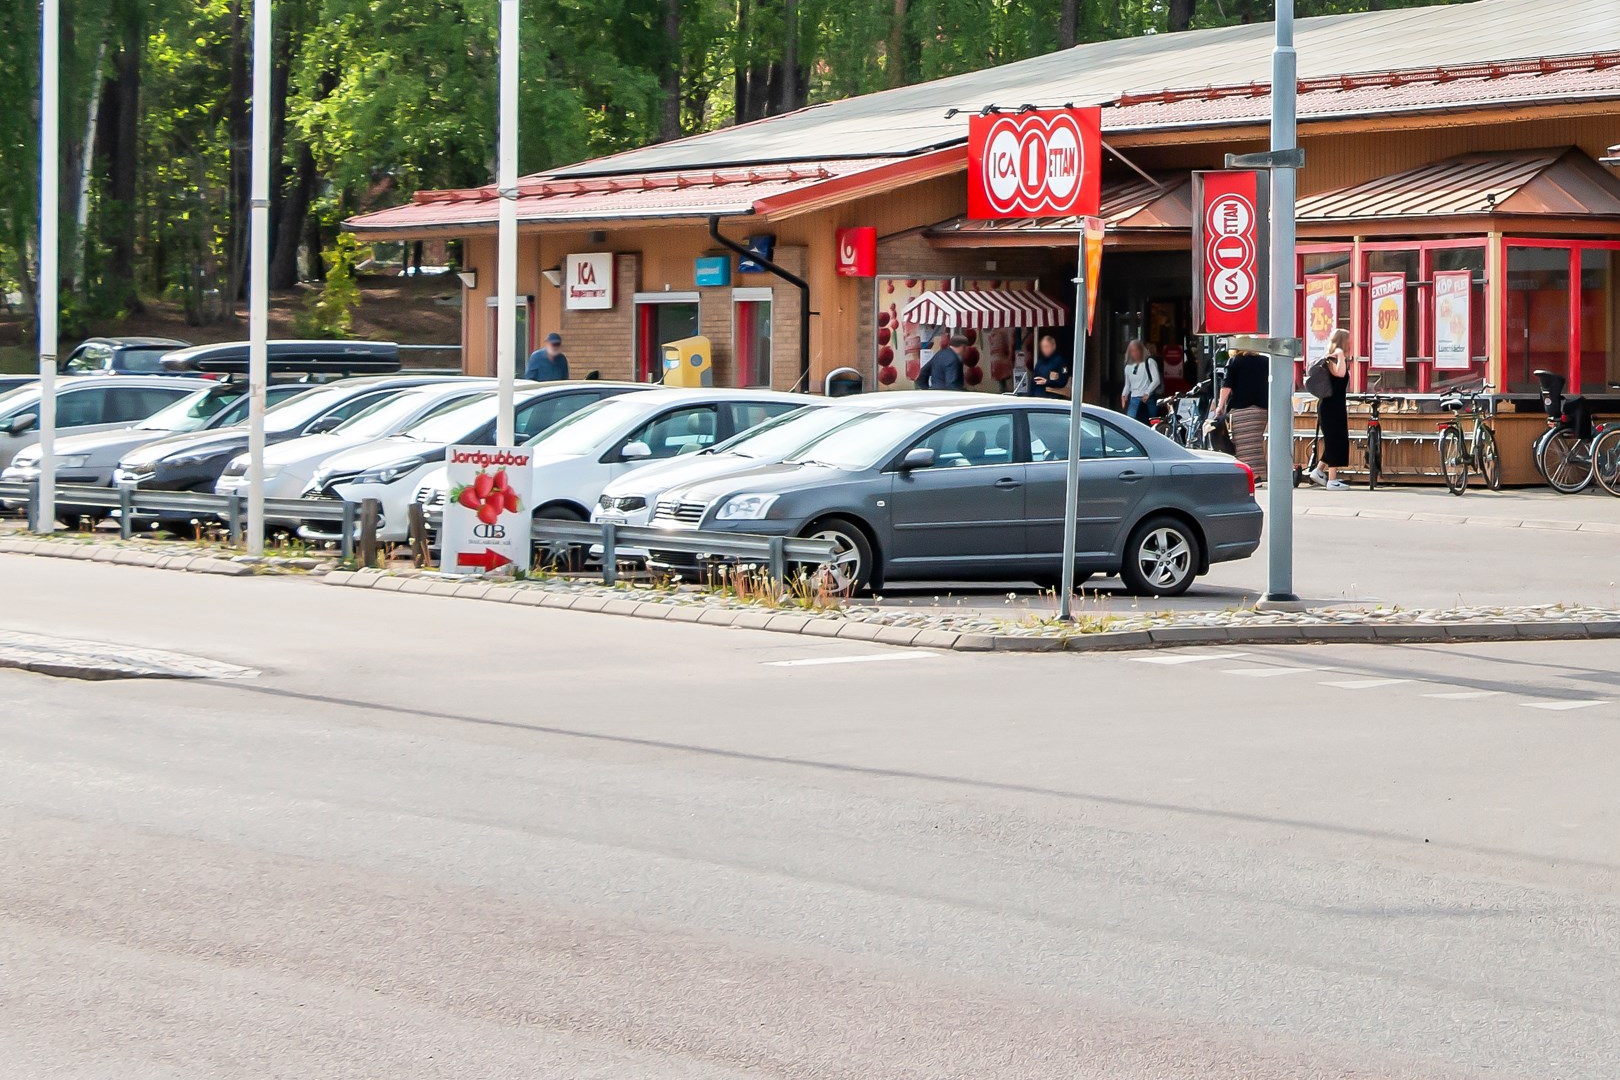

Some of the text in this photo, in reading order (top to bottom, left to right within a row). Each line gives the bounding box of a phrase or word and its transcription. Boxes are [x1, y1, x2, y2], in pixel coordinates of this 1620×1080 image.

[993, 138, 1076, 186] ICA 1 ETTAN
[1224, 203, 1239, 235] ETTAN
[577, 262, 596, 285] ICA
[1224, 271, 1239, 300] ICA
[451, 449, 530, 469] Jordgubbar
